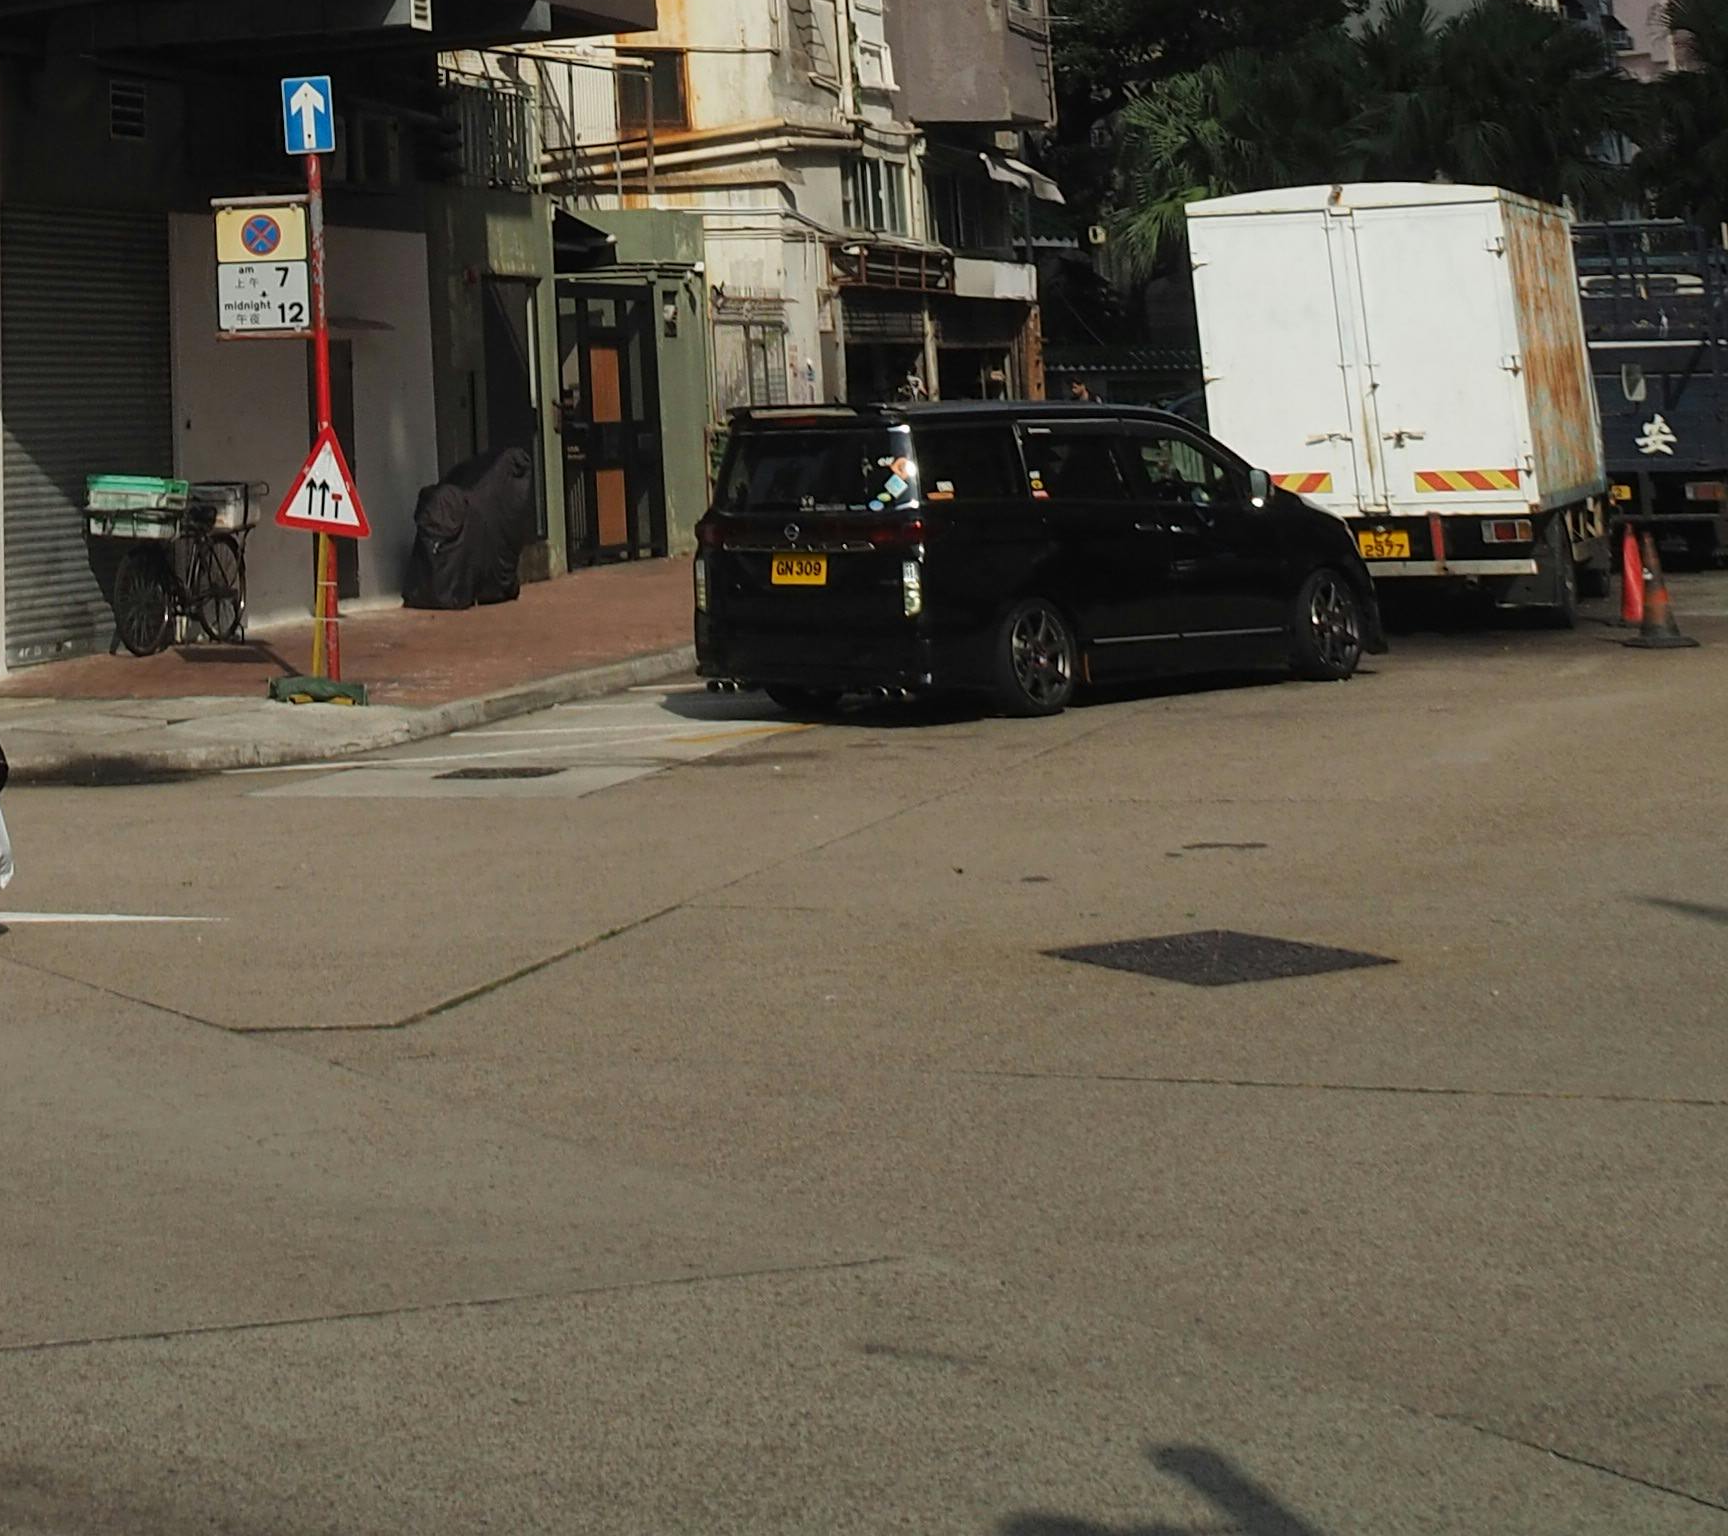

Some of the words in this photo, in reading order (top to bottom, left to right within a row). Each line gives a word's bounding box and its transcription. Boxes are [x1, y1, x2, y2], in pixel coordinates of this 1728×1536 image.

[235, 277, 259, 289] 上午
[238, 266, 255, 274] am
[275, 266, 289, 287] 7
[224, 300, 271, 312] midnight
[277, 302, 304, 324] 12
[1634, 413, 1678, 456] 安
[776, 560, 794, 577] GN
[796, 560, 822, 577] 309
